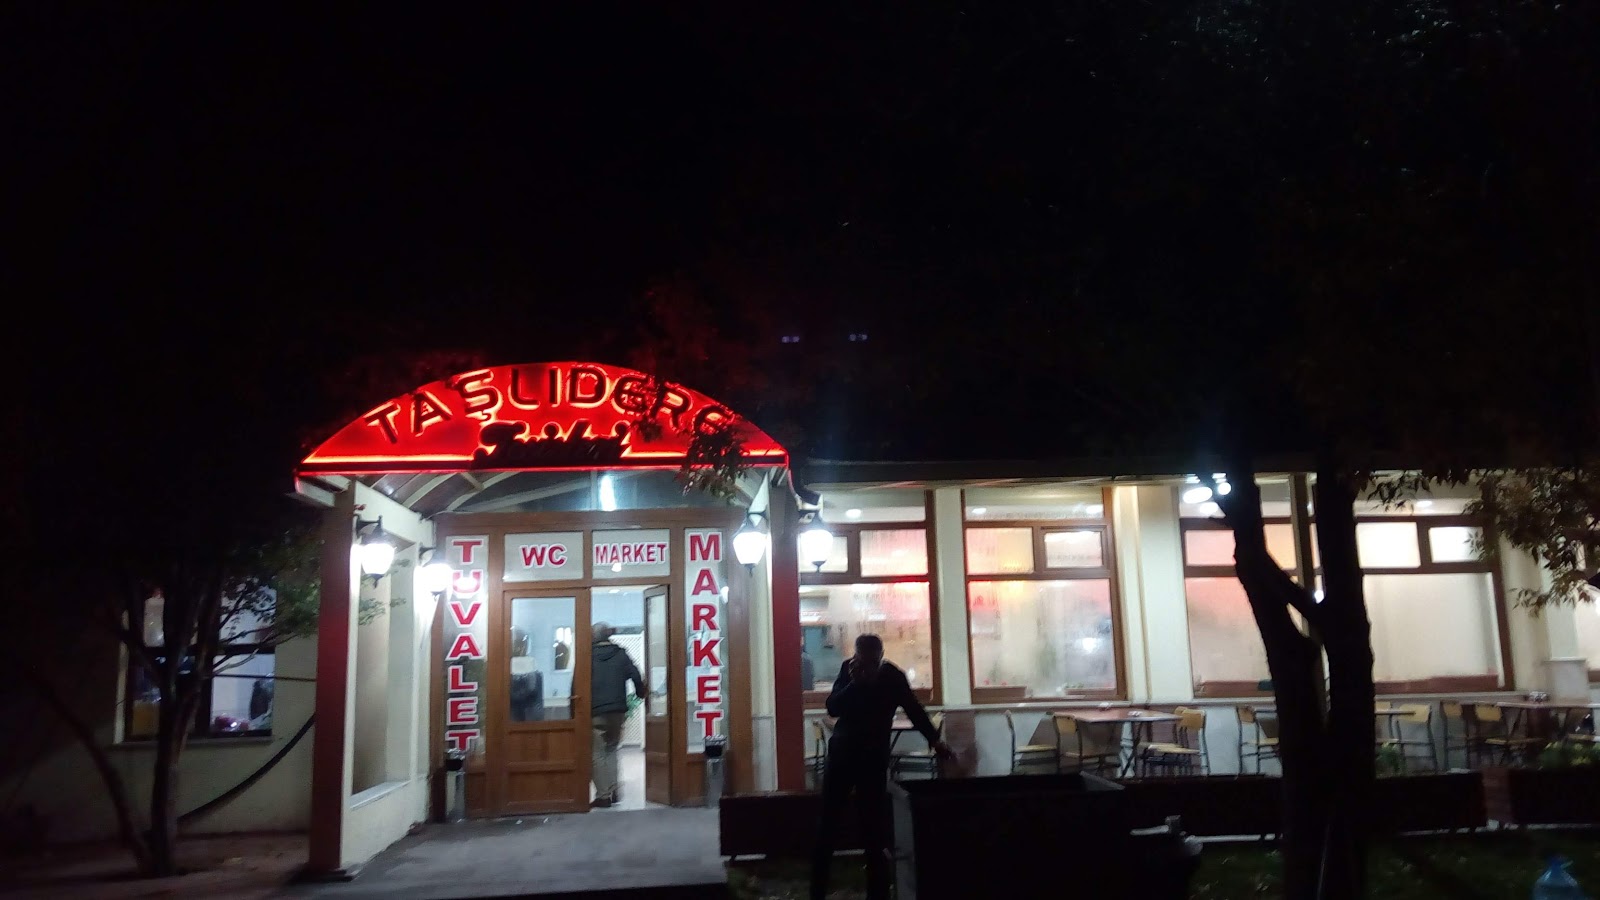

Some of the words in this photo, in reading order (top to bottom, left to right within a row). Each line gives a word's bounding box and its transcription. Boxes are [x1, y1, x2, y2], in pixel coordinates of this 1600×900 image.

[521, 544, 567, 567] WC
[594, 542, 668, 564] MARKET
[446, 539, 483, 751] TUVALET
[687, 532, 724, 737] MARKET
